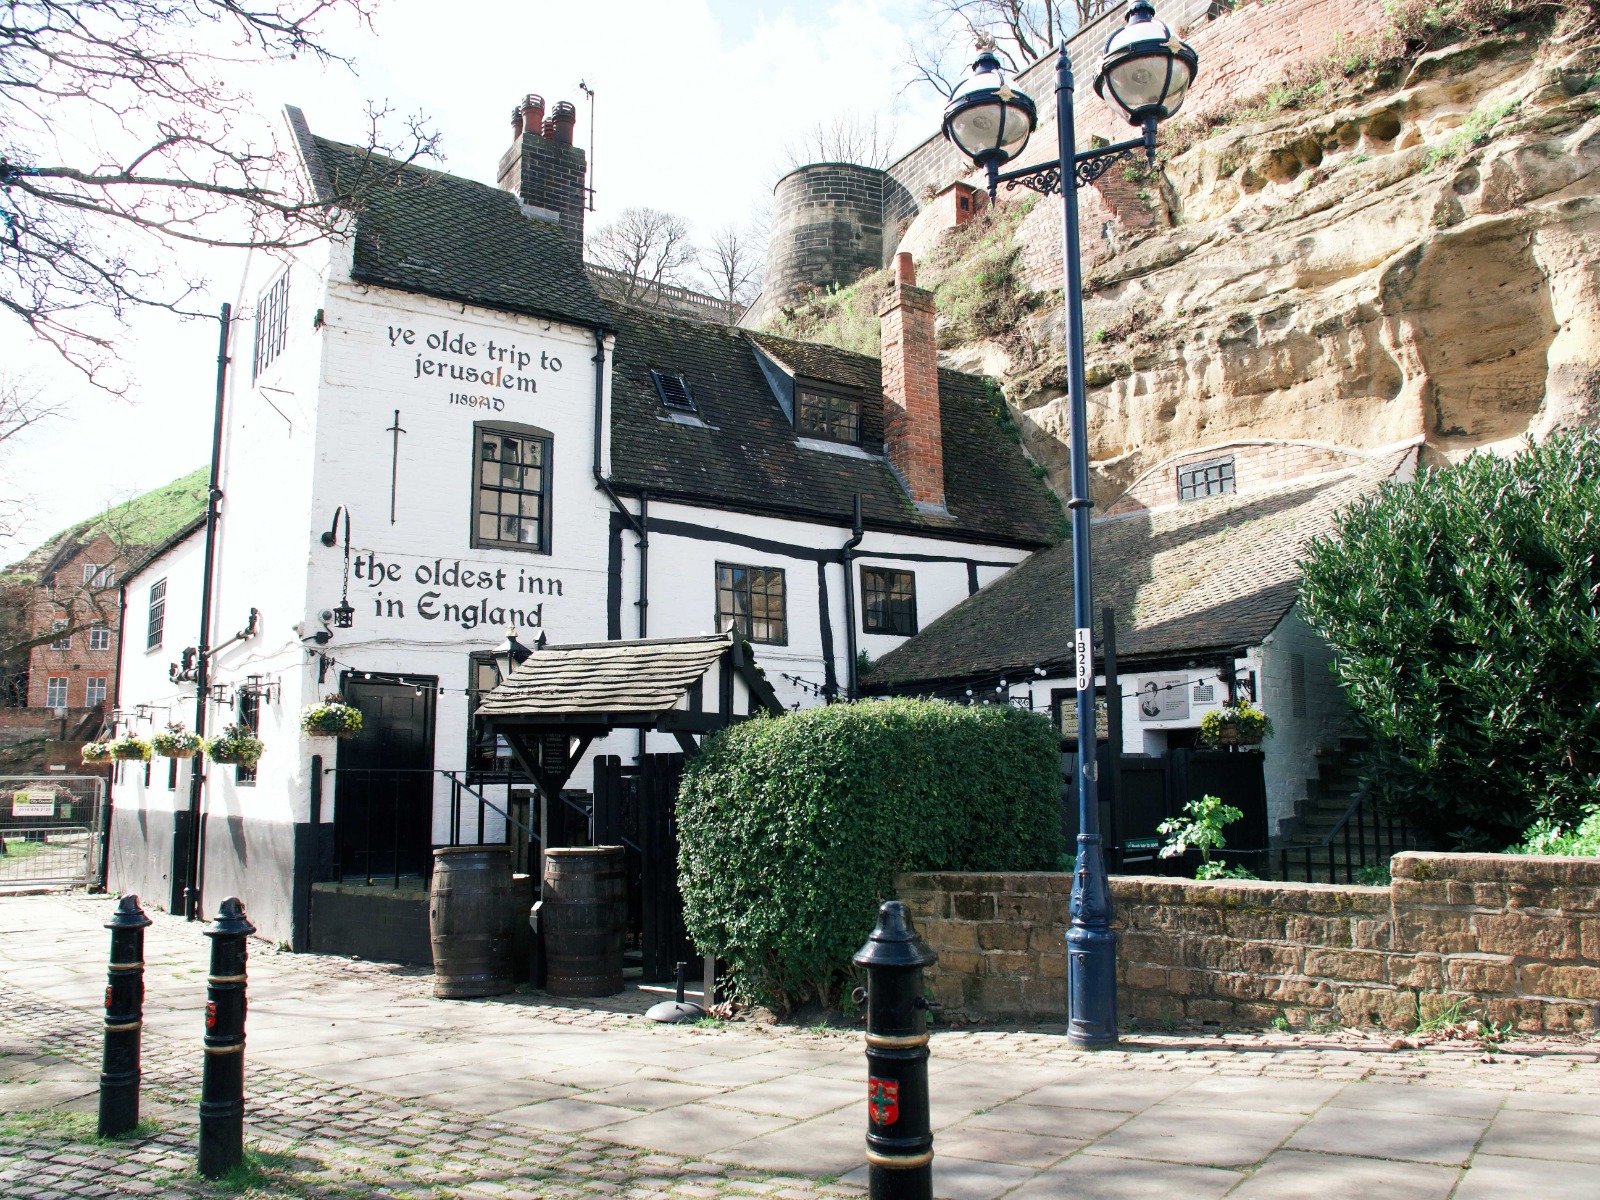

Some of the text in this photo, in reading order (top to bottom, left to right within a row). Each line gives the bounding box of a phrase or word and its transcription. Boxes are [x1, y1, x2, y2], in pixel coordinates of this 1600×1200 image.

[388, 326, 563, 372] ye olde trip to
[414, 353, 538, 394] jerusalem
[354, 552, 564, 597] the oldest inn
[375, 590, 543, 630] in England
